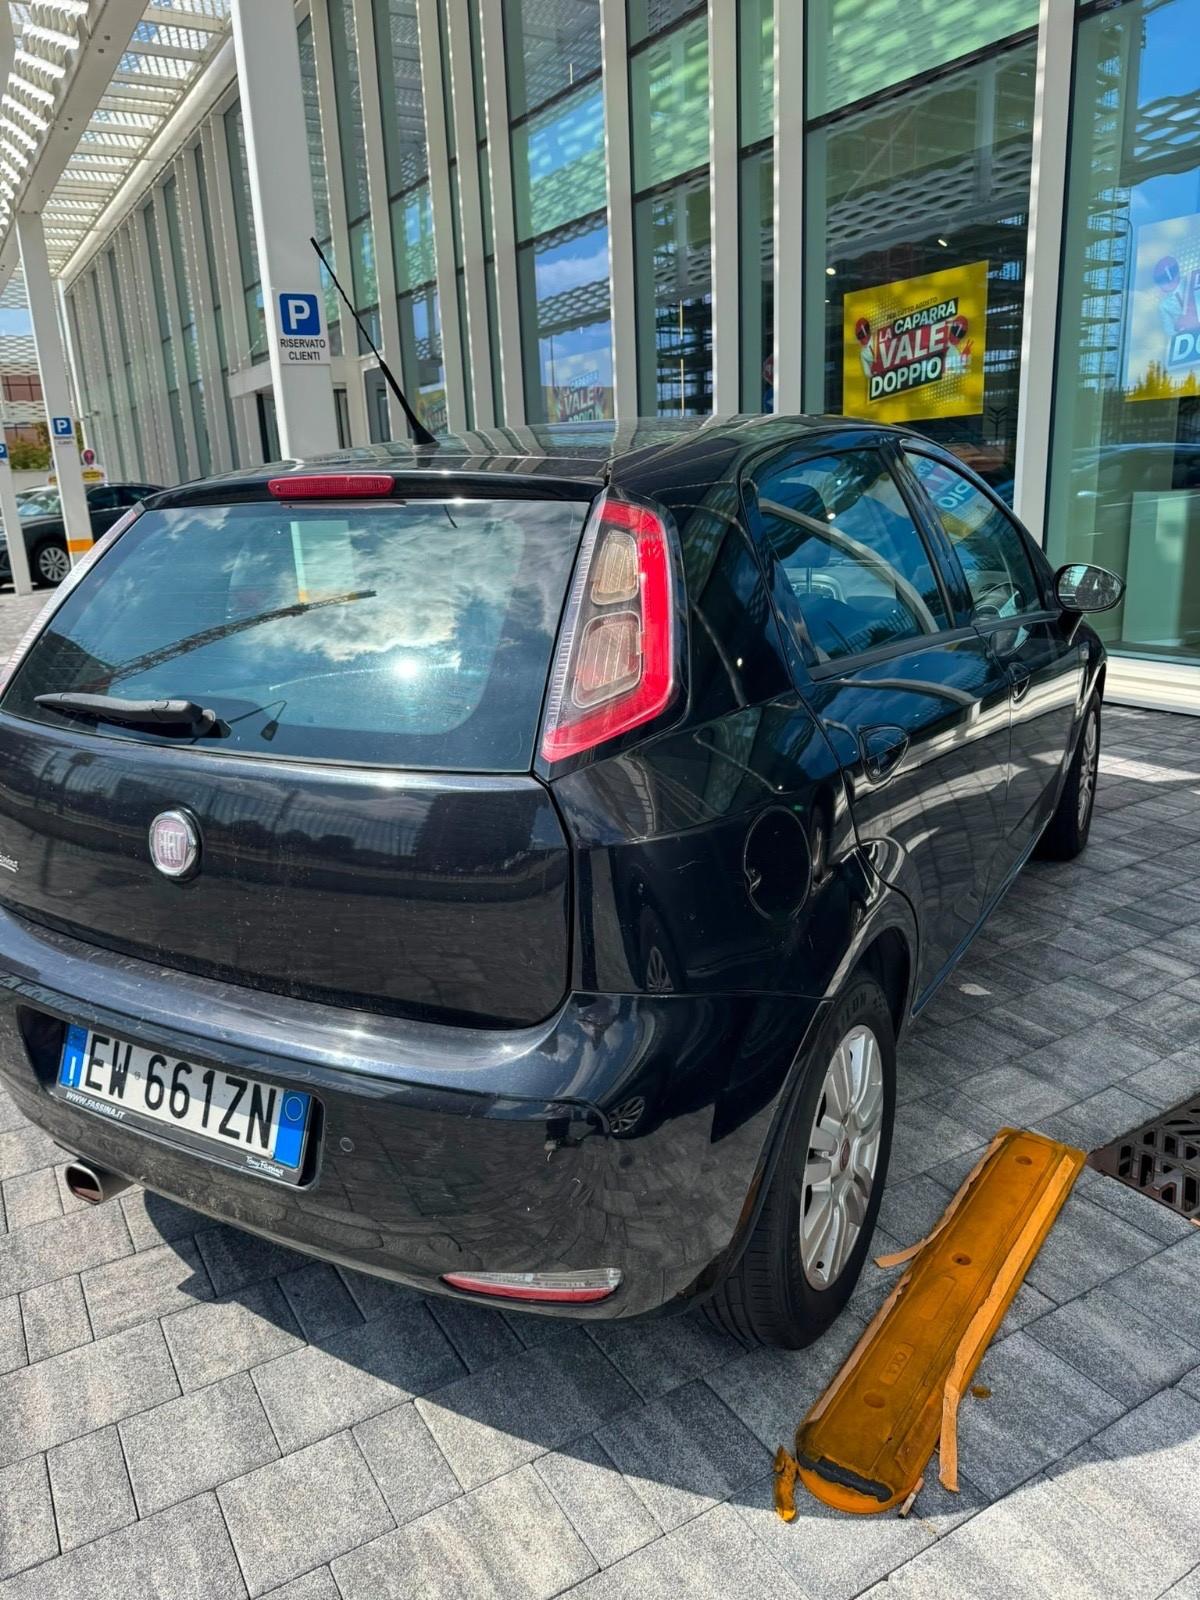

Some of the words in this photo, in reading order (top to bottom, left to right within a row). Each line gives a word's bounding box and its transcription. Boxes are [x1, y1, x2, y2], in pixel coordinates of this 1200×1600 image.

[287, 299, 311, 330] P
[879, 328, 892, 343] LA
[894, 299, 957, 335] CAPARRA
[280, 339, 326, 348] RISERVATO
[288, 351, 320, 361] CLIENTI
[879, 321, 946, 369] VALE
[871, 356, 942, 398] DOPPIO
[56, 419, 68, 433] P
[65, 1091, 126, 1119] WWW.FASSINA.IT
[84, 1033, 133, 1099] EW
[144, 1054, 277, 1149] 661ZN
